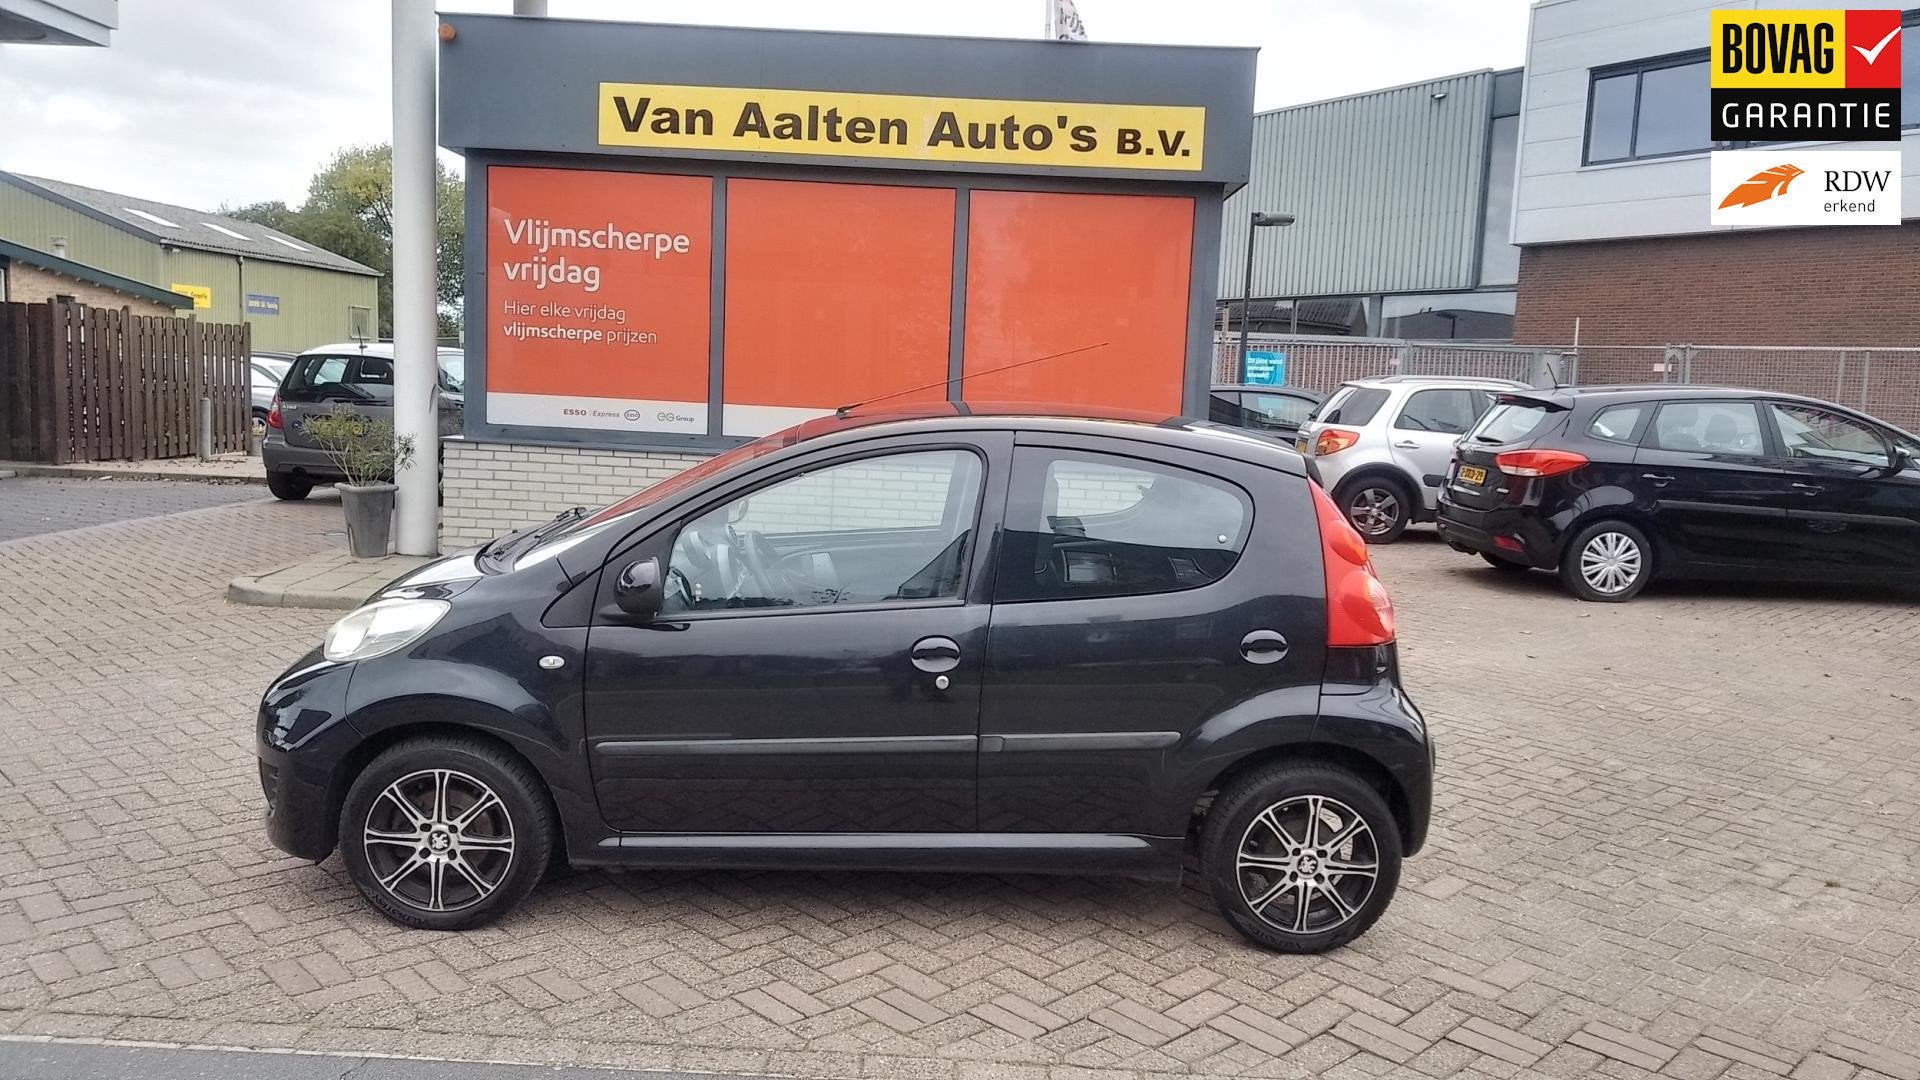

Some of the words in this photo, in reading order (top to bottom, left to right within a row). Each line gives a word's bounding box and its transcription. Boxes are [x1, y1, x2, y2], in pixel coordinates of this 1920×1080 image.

[613, 96, 714, 137] Van
[733, 102, 908, 145] Aalten
[927, 111, 1098, 153] Auto's
[1116, 128, 1190, 157] B.V.
[503, 218, 690, 260] Vlijmscherpe
[503, 256, 600, 292] vrijdag
[504, 300, 536, 316] Hier
[540, 301, 571, 318] elke
[574, 304, 627, 325] vrijdag
[503, 321, 603, 344] vlijmscherpe
[606, 328, 657, 346] prijzen
[563, 408, 587, 416] ESSO
[592, 410, 621, 419] Express
[675, 415, 695, 423] Group
